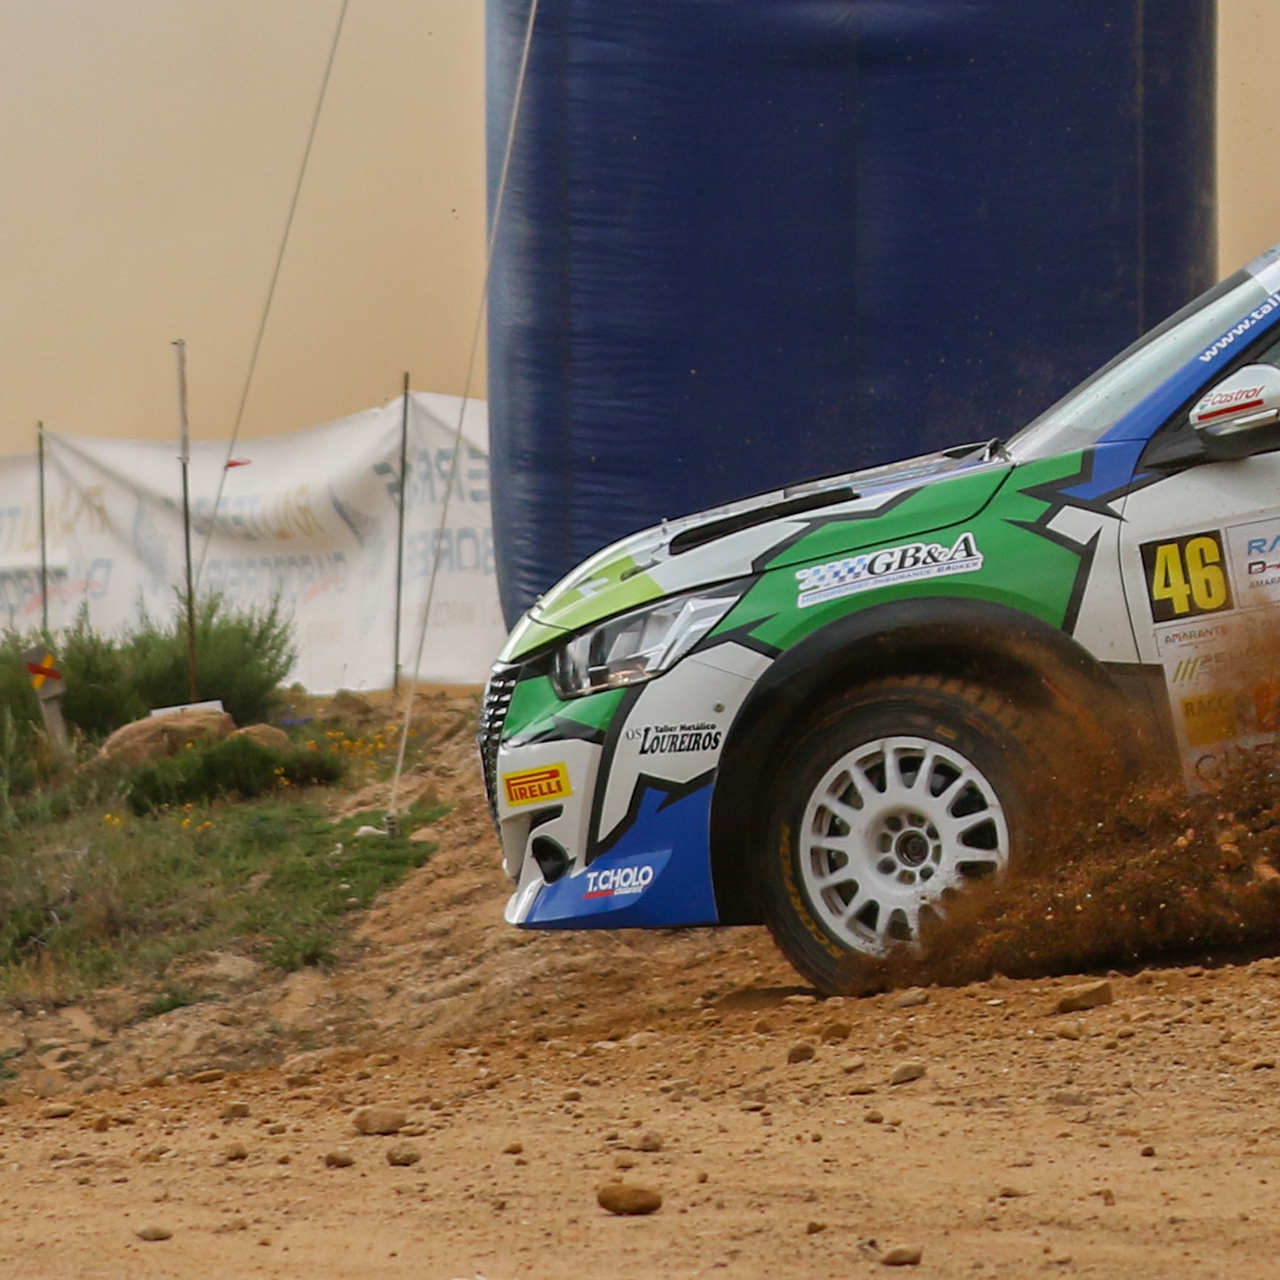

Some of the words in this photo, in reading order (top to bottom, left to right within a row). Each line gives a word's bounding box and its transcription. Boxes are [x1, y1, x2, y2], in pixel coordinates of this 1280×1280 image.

[1211, 385, 1266, 406] Castrol
[867, 535, 978, 576] GB&A
[1152, 537, 1227, 615] 46
[639, 726, 722, 755] LOUREIROS
[505, 769, 563, 802] PIRELLI
[587, 864, 654, 893] T.CHOLO
